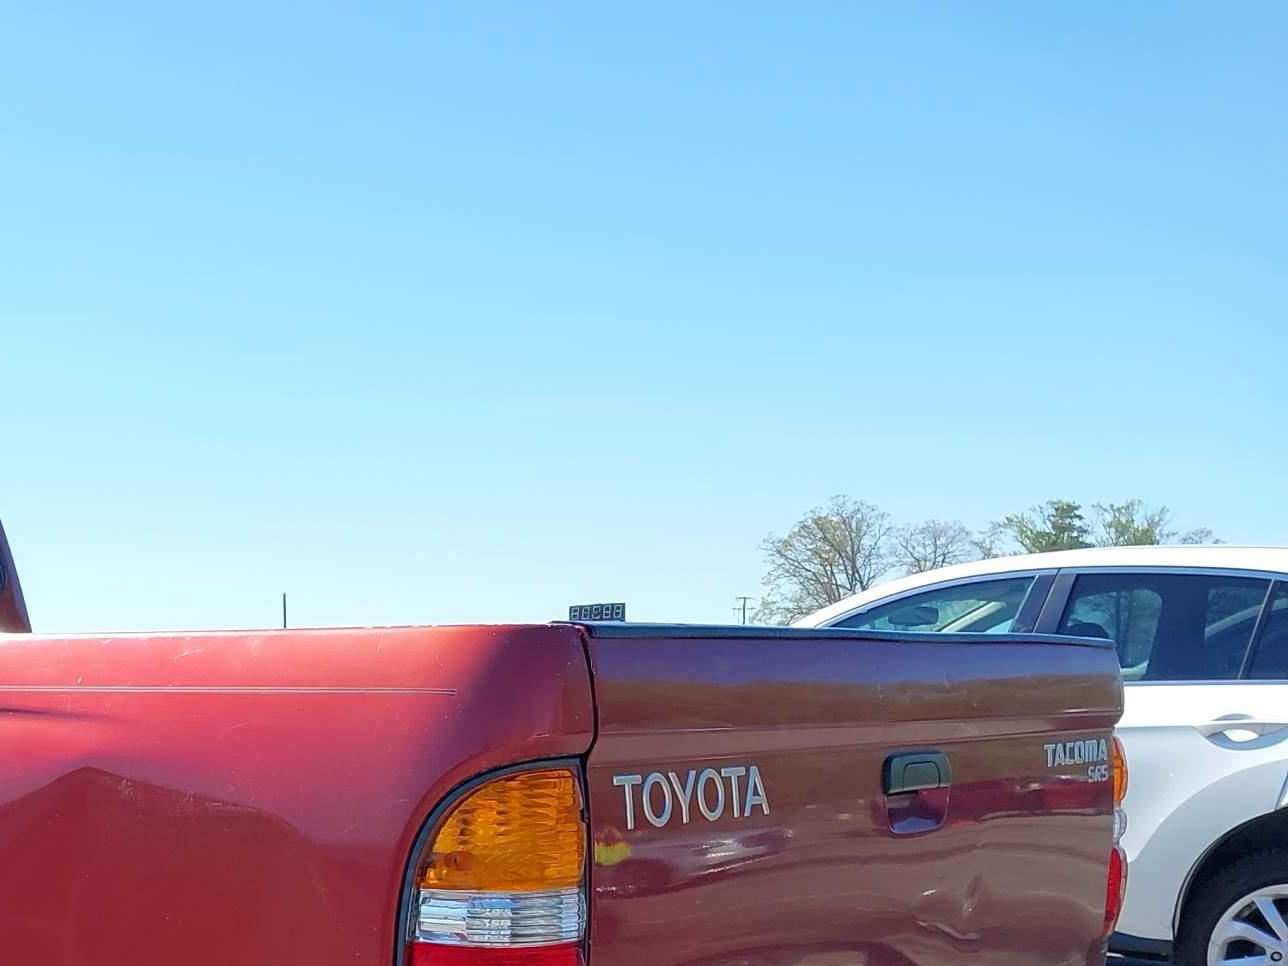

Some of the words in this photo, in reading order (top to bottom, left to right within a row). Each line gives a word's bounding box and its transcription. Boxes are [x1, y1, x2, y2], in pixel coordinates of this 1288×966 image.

[1043, 739, 1108, 768] TACOMA
[1087, 764, 1109, 783] SR5
[612, 765, 770, 831] TOYOTA
